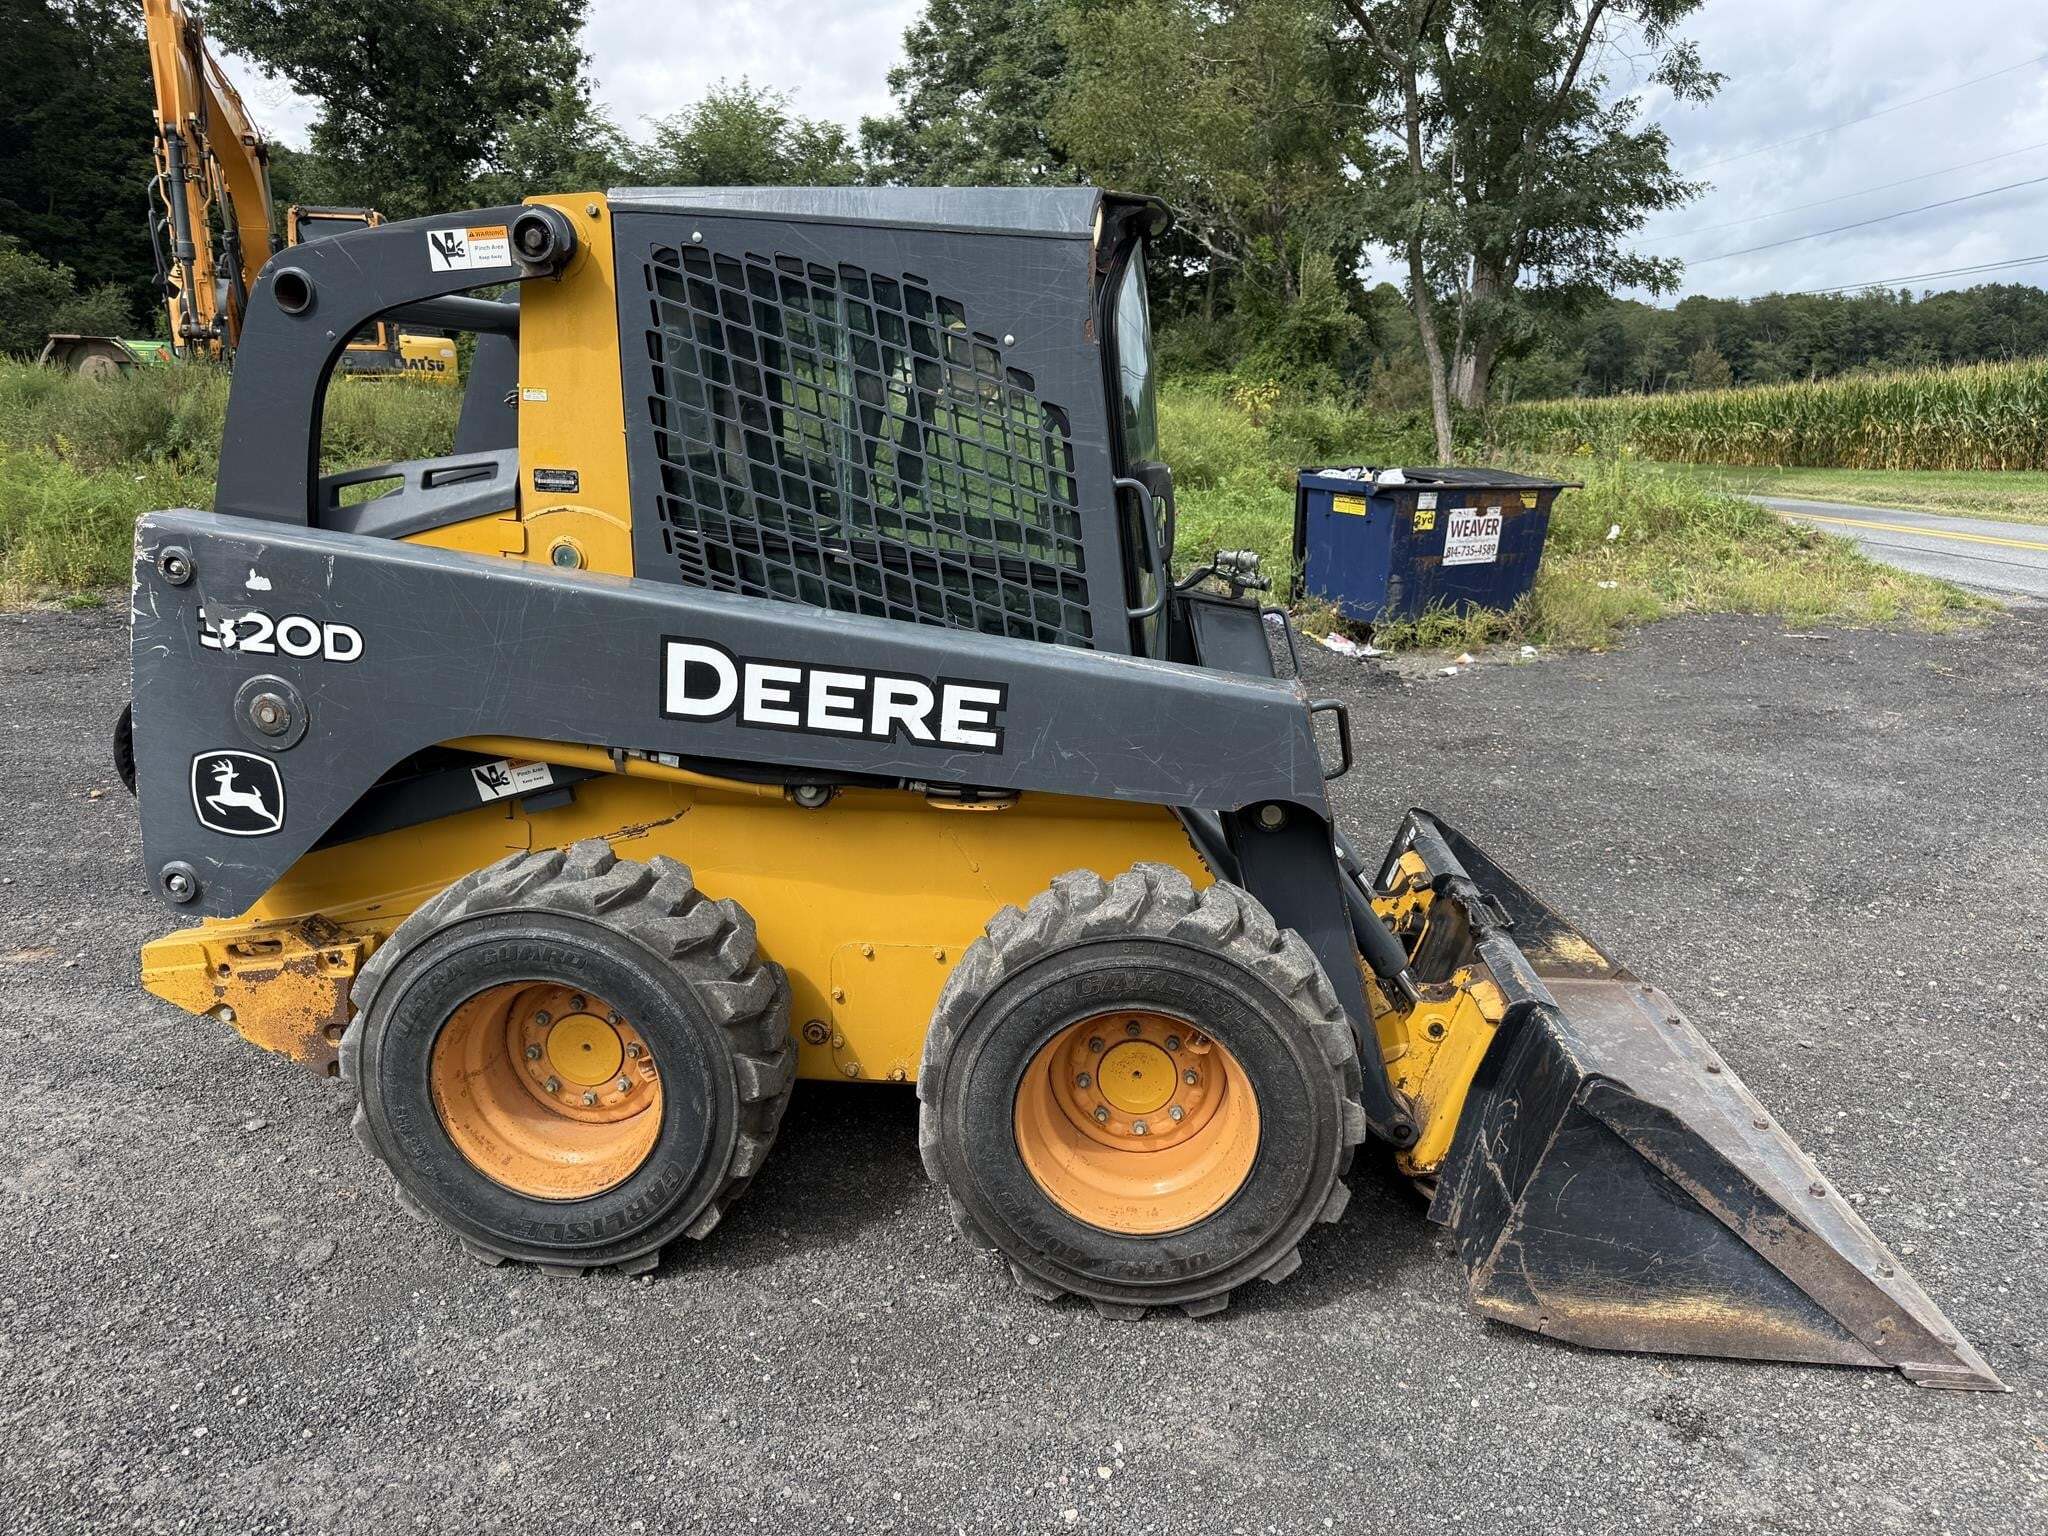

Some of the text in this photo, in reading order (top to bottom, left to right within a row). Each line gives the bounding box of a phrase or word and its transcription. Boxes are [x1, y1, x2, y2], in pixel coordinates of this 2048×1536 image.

[475, 229, 505, 238] WARNING
[1415, 513, 1433, 528] 2yd
[1451, 518, 1499, 538] WEAVER
[1446, 544, 1496, 557] 814-735-4589
[198, 608, 363, 662] 320D
[666, 641, 1001, 748] DEERE
[475, 915, 524, 931] DUTY
[482, 945, 588, 969] GUARD
[513, 1160, 684, 1243] CARLISLE
